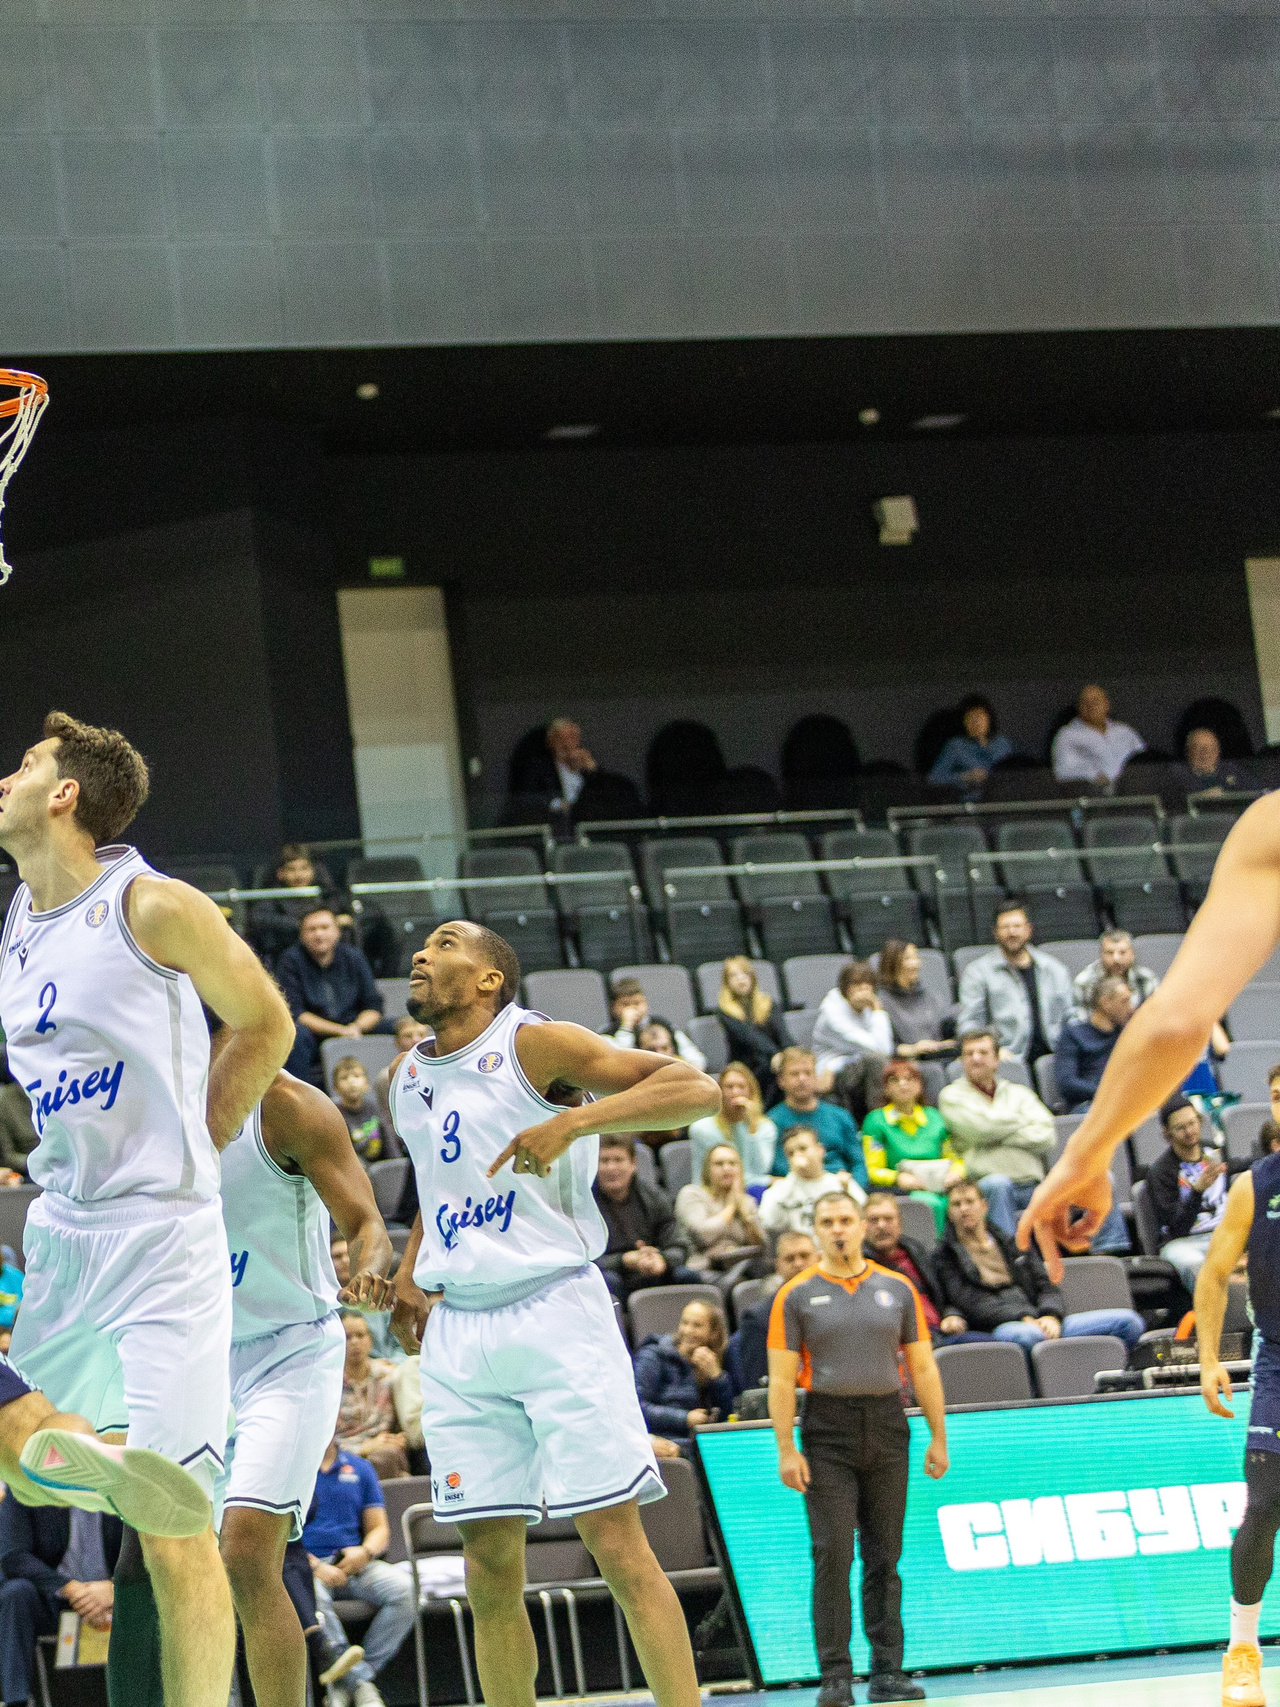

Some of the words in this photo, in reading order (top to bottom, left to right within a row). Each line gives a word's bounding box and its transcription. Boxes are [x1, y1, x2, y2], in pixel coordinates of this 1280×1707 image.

[35, 981, 57, 1035] 2
[440, 1110, 462, 1163] 3
[937, 1481, 1248, 1571] СИБУР
